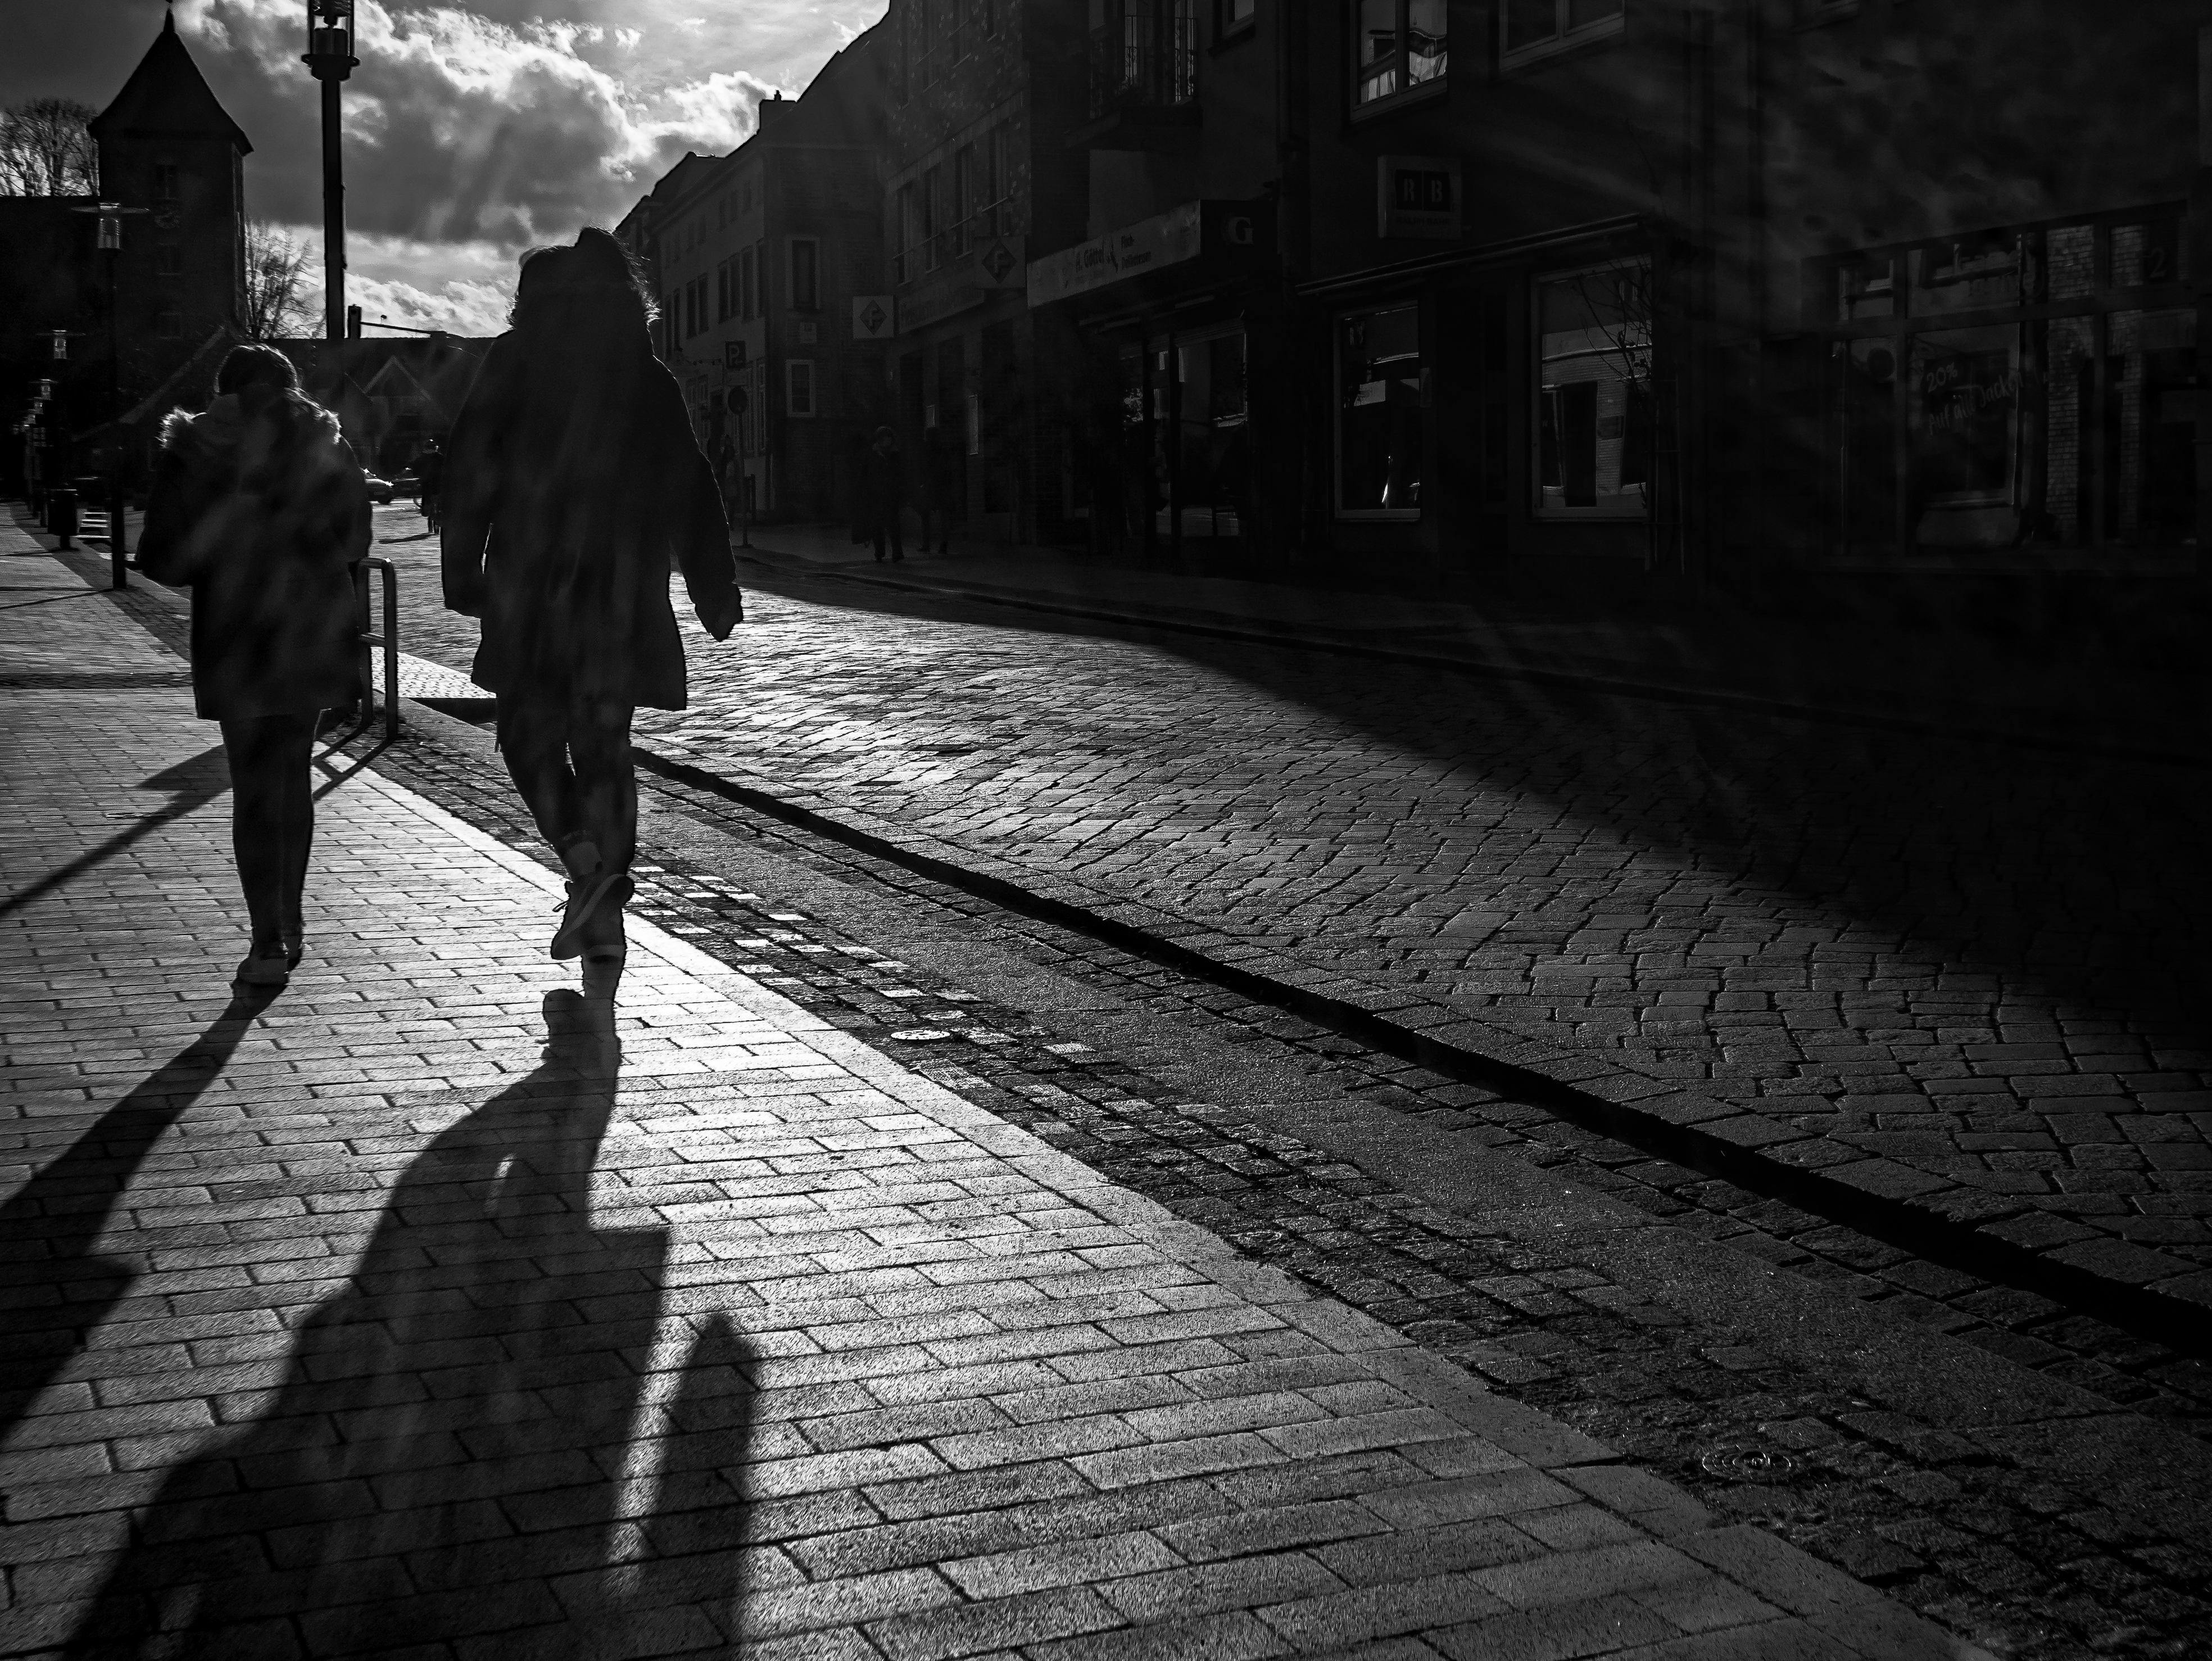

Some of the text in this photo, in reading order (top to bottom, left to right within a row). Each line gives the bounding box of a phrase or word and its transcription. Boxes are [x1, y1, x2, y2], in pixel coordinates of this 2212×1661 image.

[1404, 178, 1443, 203] R B
[1228, 216, 1254, 245] G
[1396, 216, 1425, 225] RALPH
[728, 344, 740, 366] P
[1927, 361, 1958, 393] 20%
[1952, 371, 2024, 408] Jacken
